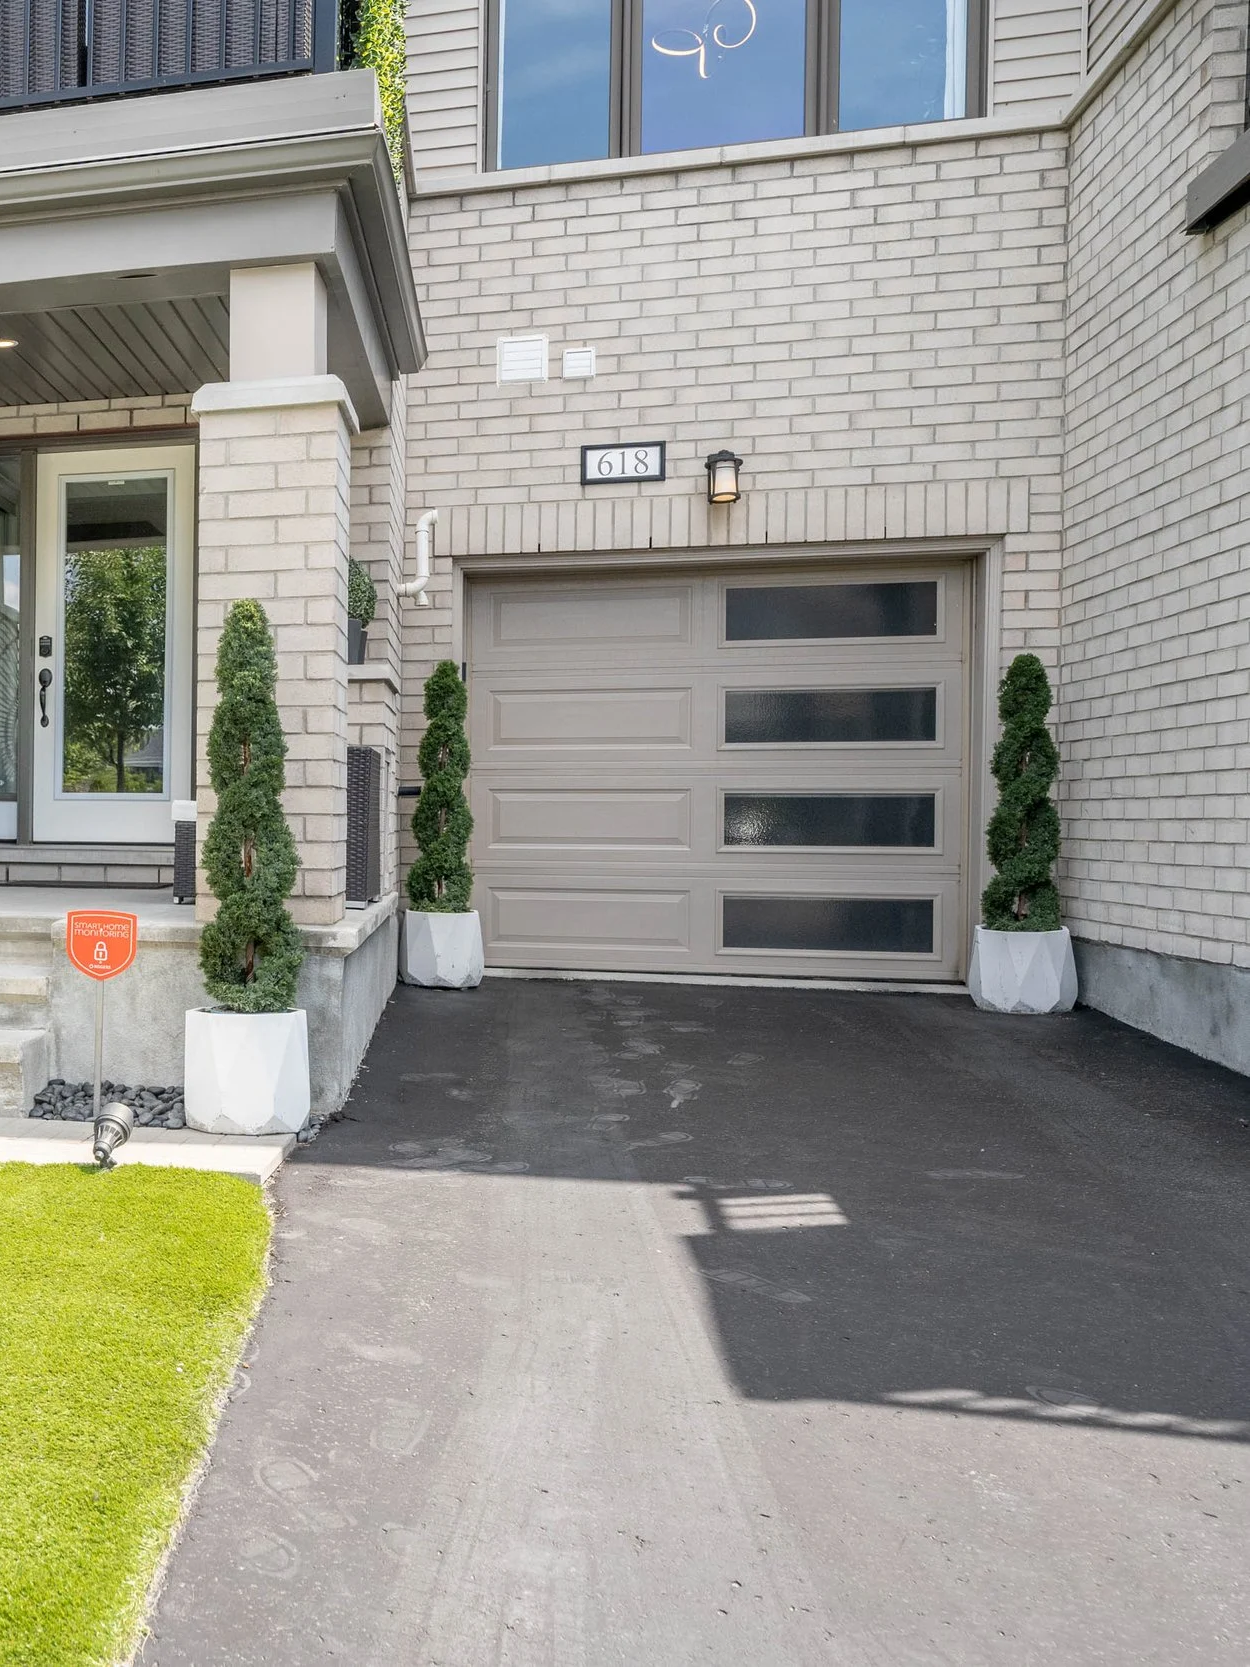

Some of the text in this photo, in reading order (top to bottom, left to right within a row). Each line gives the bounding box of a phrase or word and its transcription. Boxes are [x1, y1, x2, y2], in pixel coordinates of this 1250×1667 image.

[597, 449, 649, 477] 618
[103, 923, 129, 931] HOME
[74, 928, 129, 938] MONITORING
